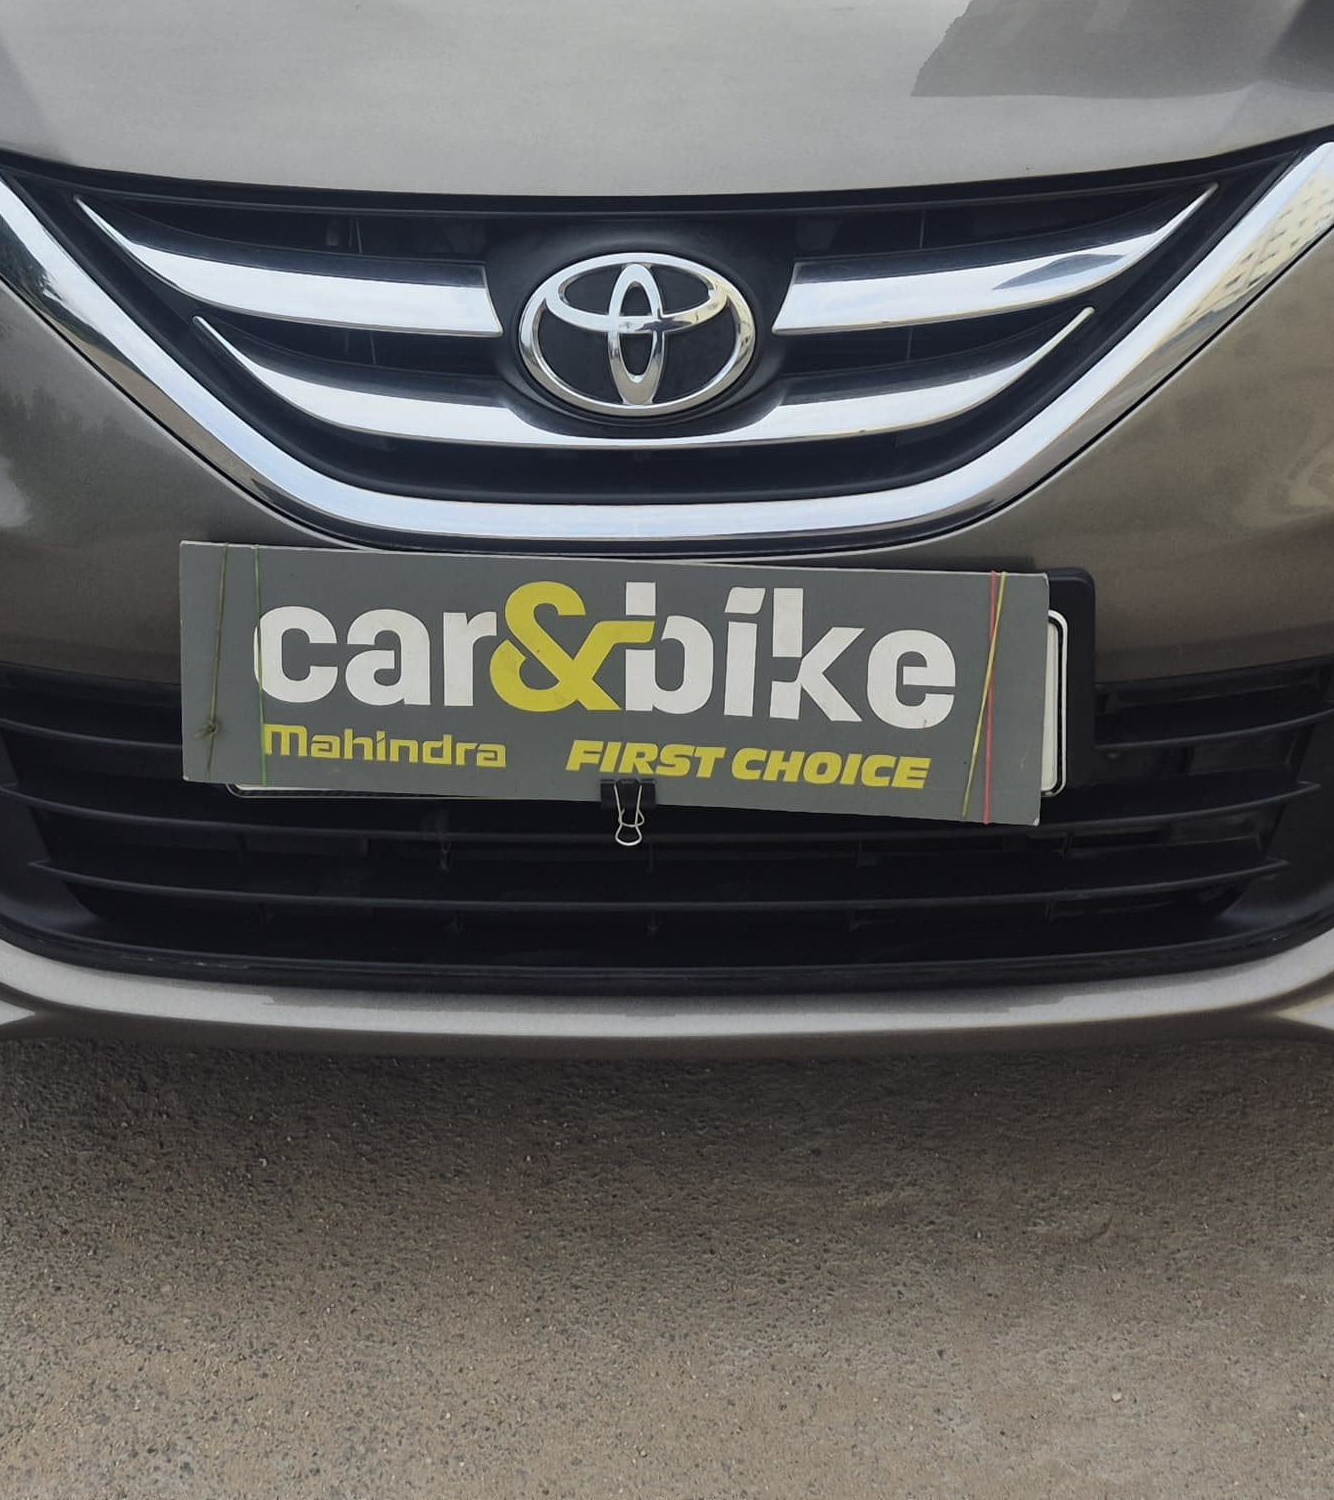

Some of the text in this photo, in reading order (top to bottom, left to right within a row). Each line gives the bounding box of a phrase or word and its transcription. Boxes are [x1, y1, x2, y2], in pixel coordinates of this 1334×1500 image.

[254, 581, 956, 729] car&bike
[264, 724, 932, 789] Mahindra FIRST CHOICE
